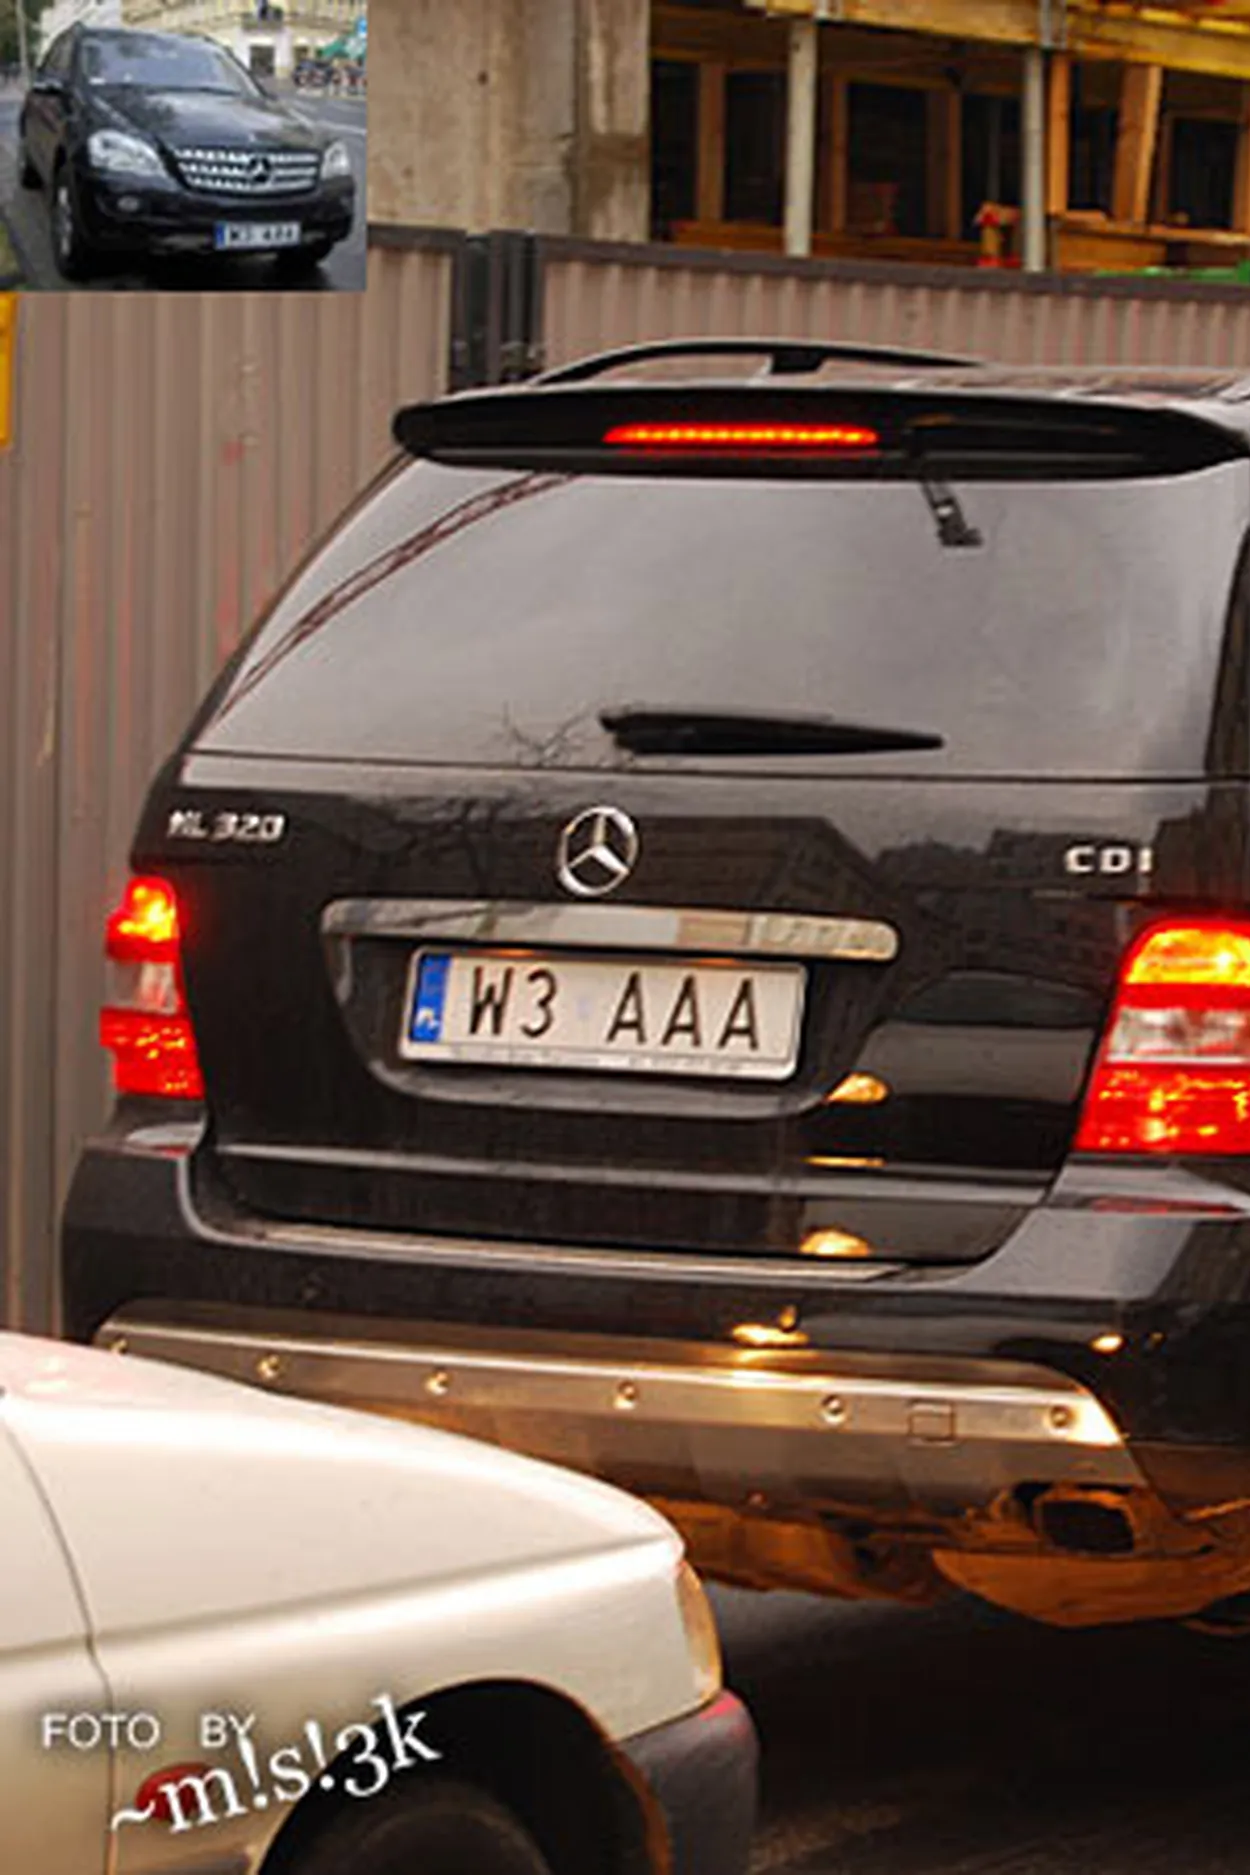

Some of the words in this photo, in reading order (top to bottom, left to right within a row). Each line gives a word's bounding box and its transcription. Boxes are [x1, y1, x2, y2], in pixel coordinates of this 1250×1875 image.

[211, 812, 285, 842] 320
[1065, 845, 1152, 873] CDI
[468, 966, 558, 1039] W3
[606, 971, 760, 1051] AAA
